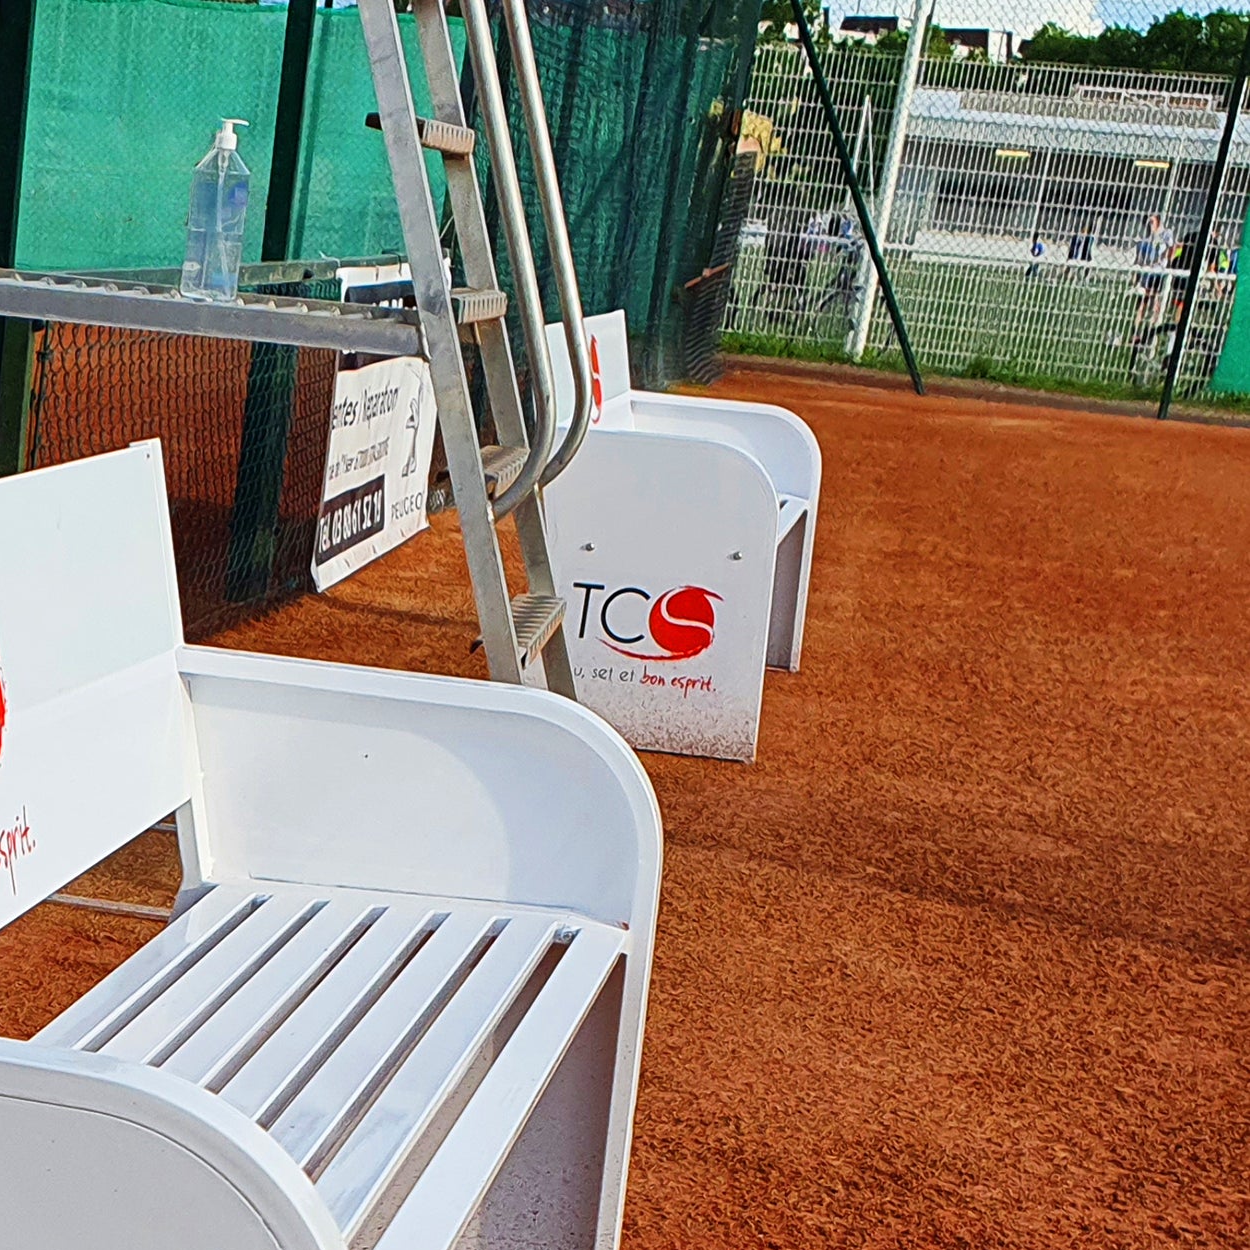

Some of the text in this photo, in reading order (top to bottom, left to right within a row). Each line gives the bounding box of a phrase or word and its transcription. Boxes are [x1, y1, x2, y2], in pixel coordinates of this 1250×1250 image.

[391, 490, 425, 522] PEUGEO
[591, 666, 613, 683] set
[619, 669, 636, 683] et
[640, 664, 666, 687] bon
[670, 675, 717, 699] esprit.
